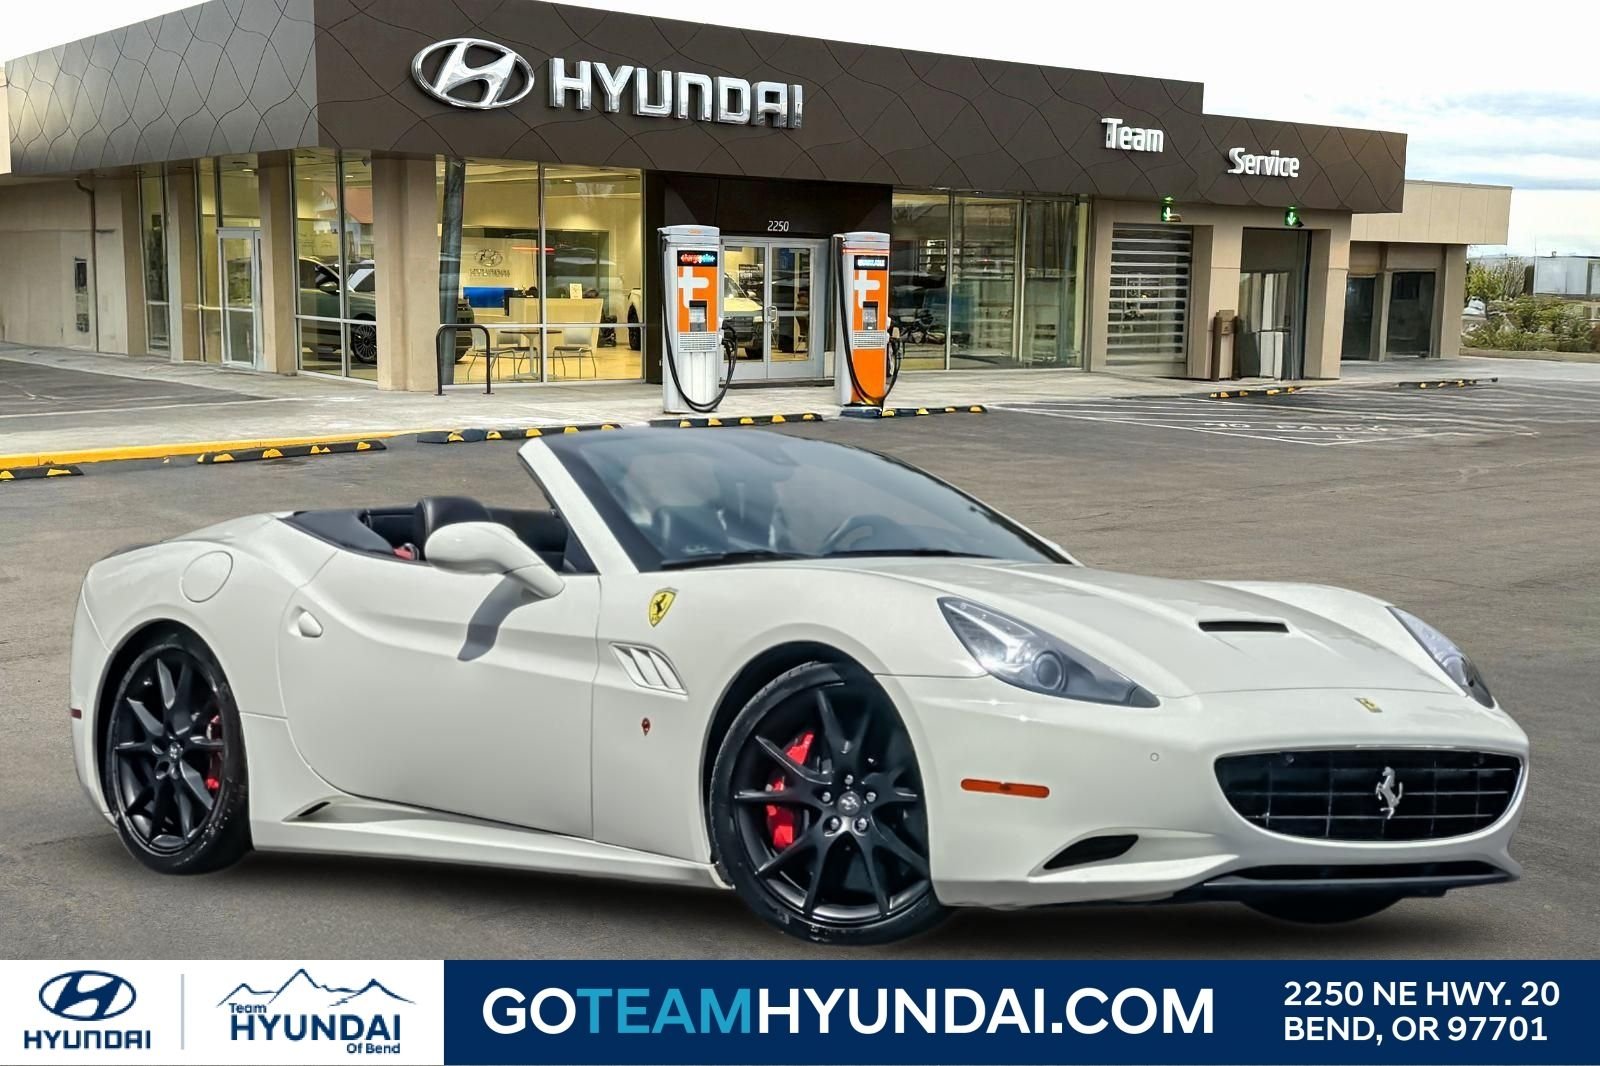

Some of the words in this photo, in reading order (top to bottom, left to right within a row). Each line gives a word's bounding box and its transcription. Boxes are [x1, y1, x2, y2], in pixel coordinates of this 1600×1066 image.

[549, 57, 803, 129] HYUNDAI
[1101, 117, 1164, 152] Team
[1228, 147, 1300, 177] Service
[767, 220, 790, 232] 2250
